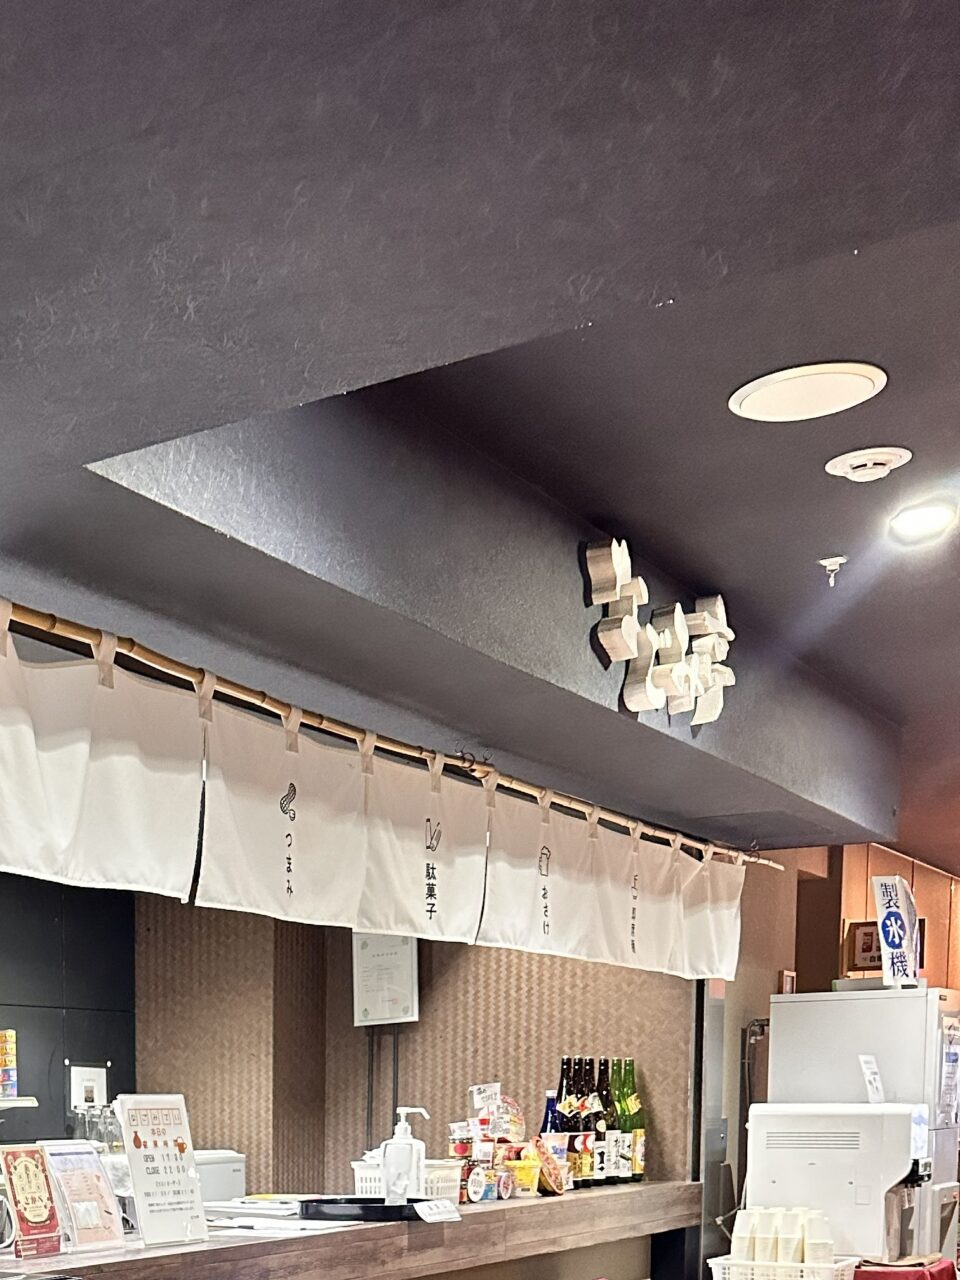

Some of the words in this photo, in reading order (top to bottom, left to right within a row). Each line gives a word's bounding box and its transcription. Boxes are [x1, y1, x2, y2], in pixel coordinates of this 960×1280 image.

[285, 833, 293, 897] つまみ
[425, 863, 437, 920] 駄菓子
[541, 886, 549, 935] おさけ
[880, 882, 909, 978] 製氷機
